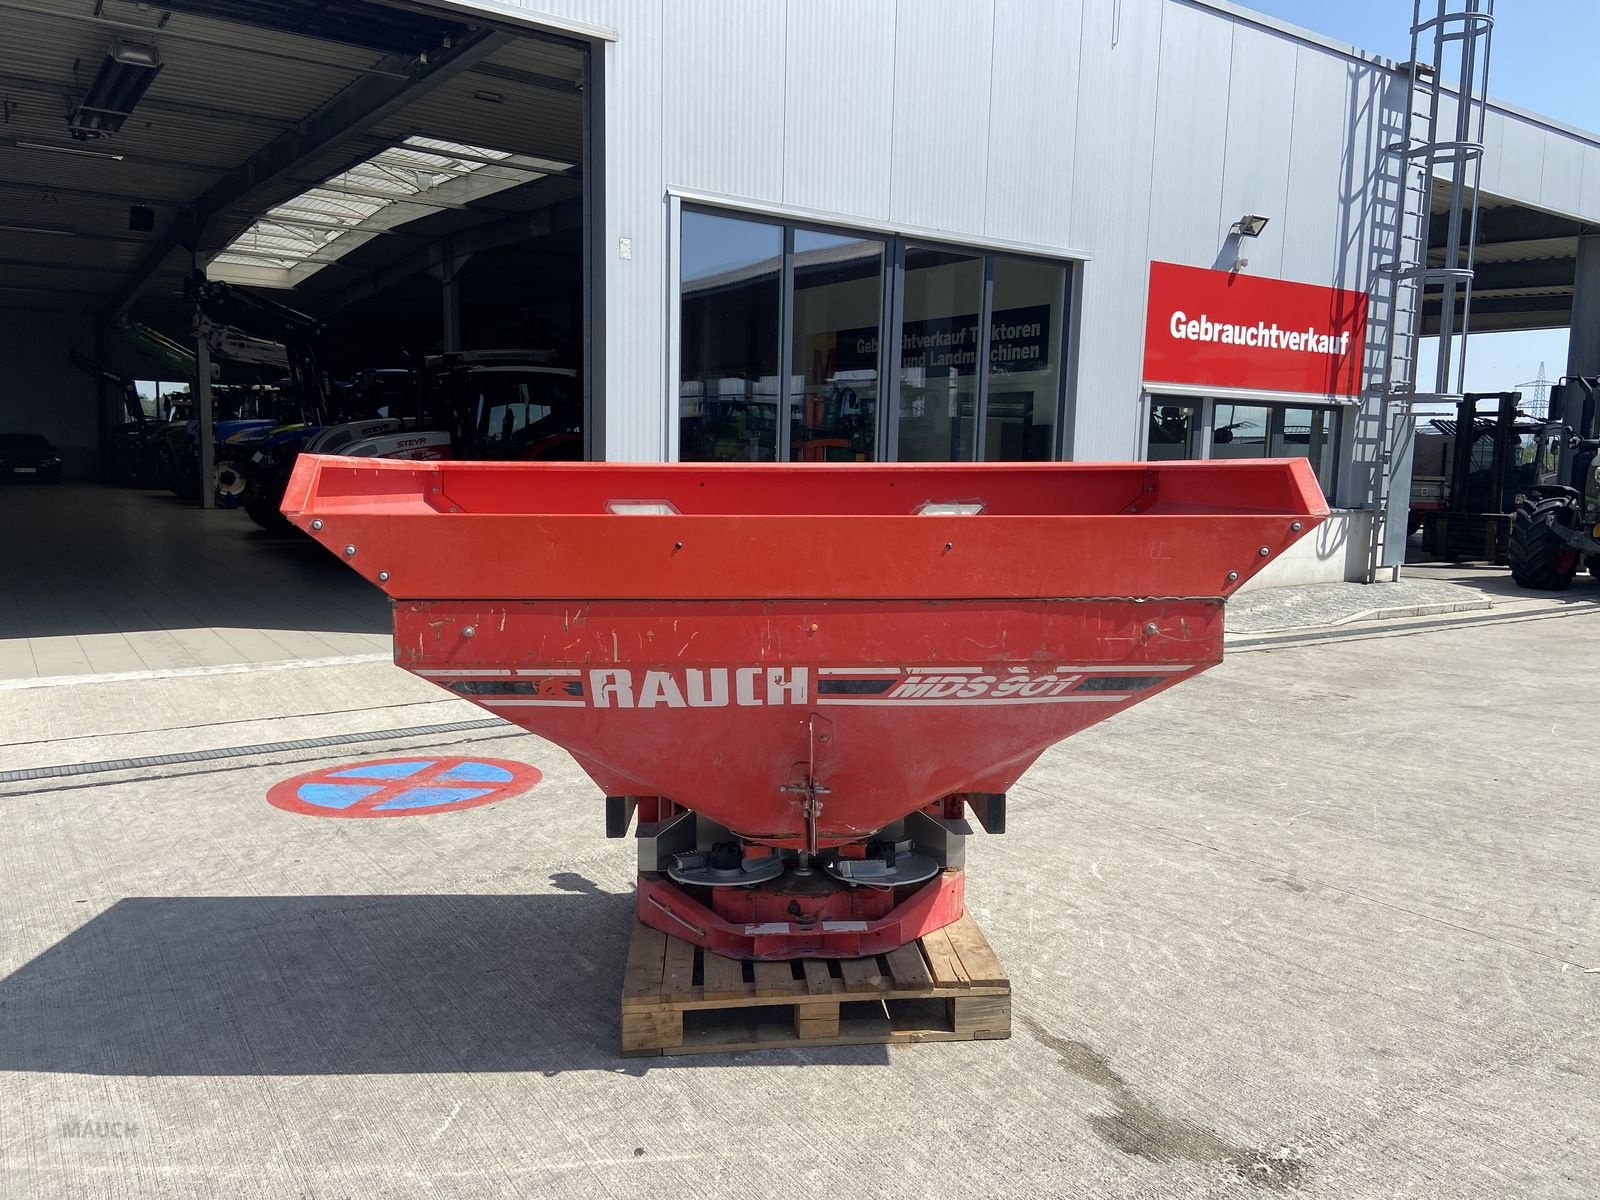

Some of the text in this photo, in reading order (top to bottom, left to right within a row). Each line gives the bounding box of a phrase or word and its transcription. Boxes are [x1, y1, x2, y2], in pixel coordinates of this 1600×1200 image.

[856, 323, 1041, 354] Gebhtverkauf Tktoren
[1170, 311, 1349, 355] Gebrauchtverkauf
[903, 351, 925, 367] und
[397, 438, 427, 448] STEYR
[589, 667, 808, 708] RAUCH
[888, 674, 1083, 698] MDS 901
